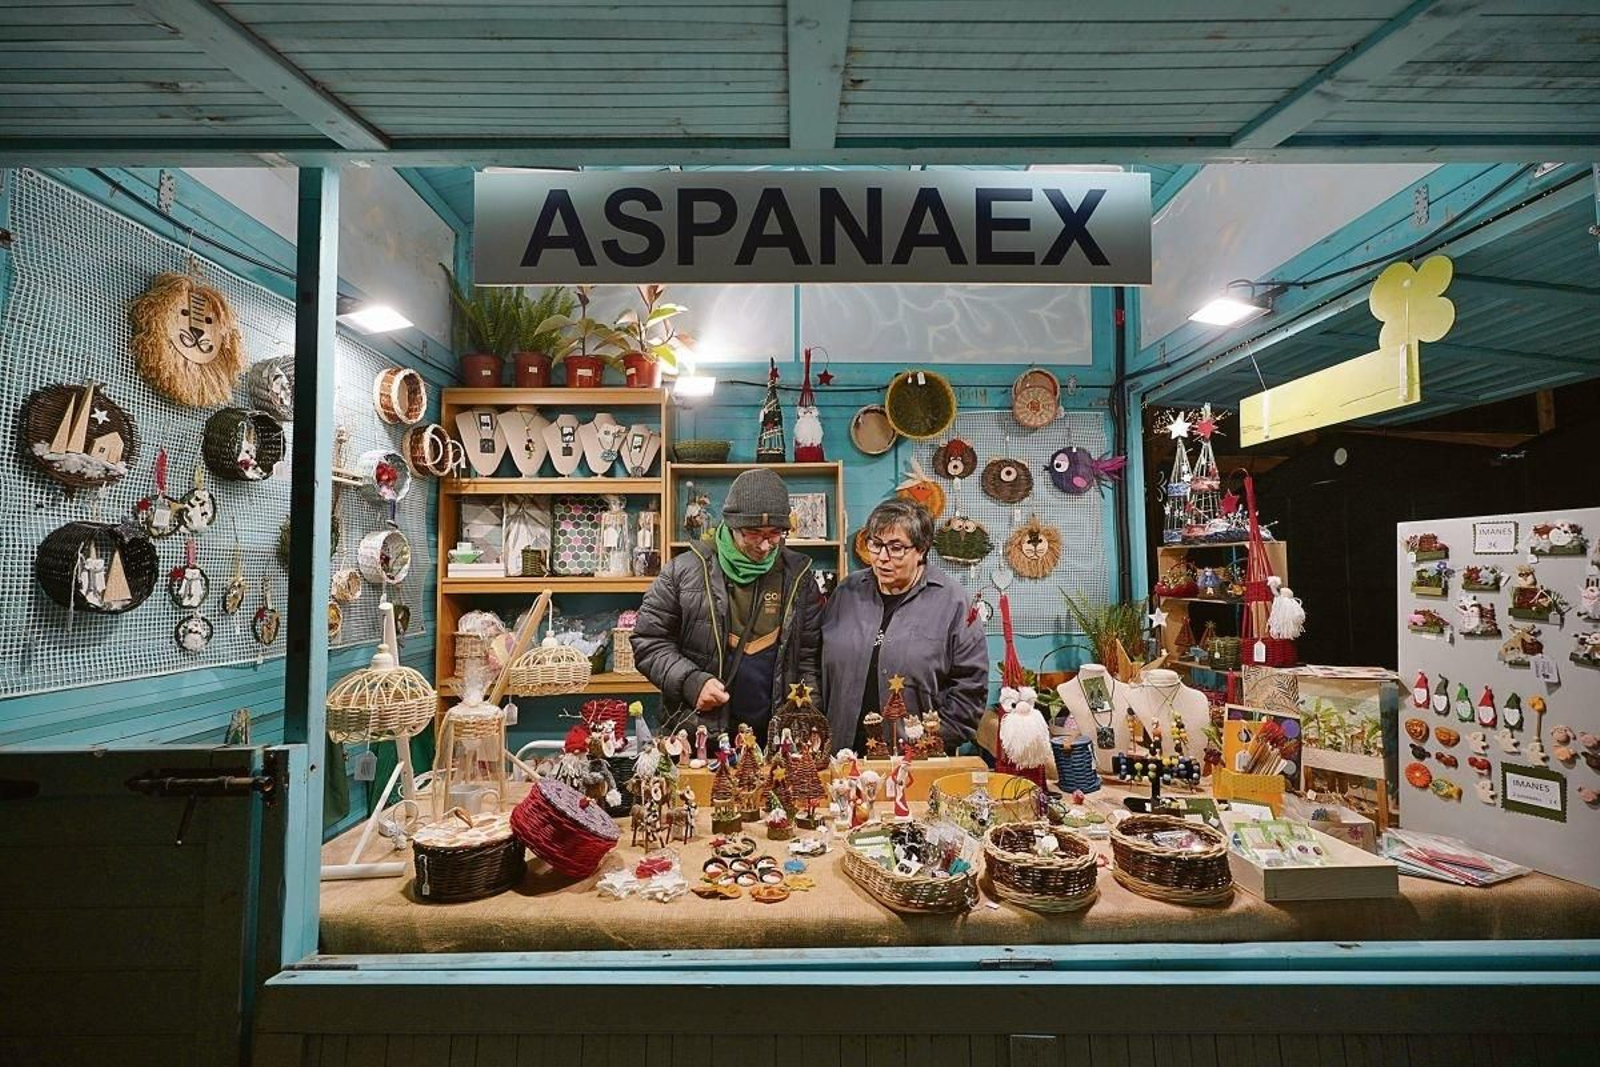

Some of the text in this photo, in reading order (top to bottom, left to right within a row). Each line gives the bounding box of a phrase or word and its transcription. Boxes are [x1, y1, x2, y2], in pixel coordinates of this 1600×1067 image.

[520, 187, 1111, 268] ASPANAEX
[1479, 528, 1513, 536] IMANES
[1512, 779, 1550, 793] IMANES
